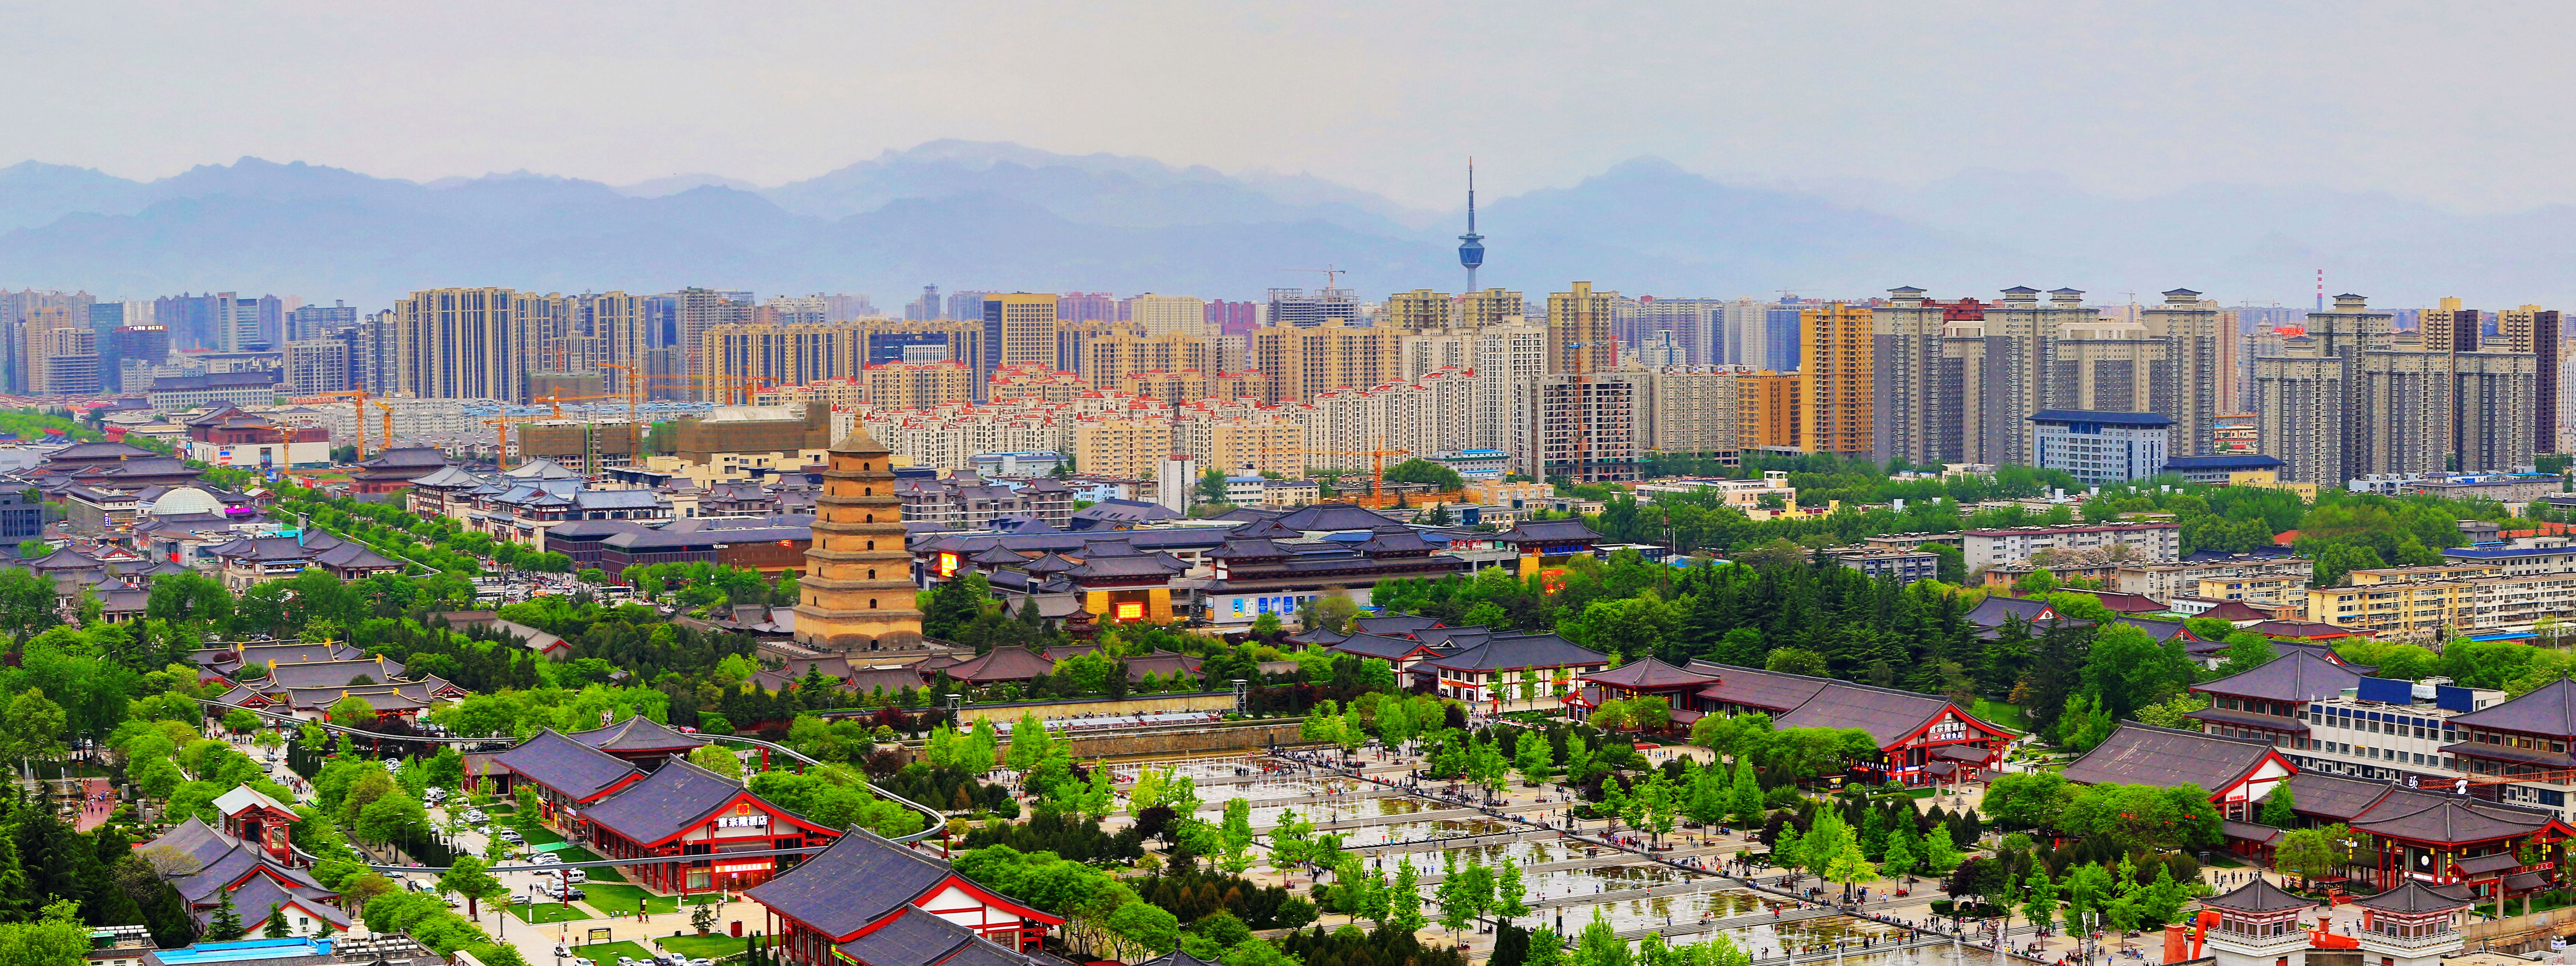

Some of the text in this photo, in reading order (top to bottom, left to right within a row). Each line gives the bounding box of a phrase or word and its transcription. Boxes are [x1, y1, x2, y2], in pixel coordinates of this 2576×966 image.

[1929, 722, 1967, 733] 唐宗隆酒店
[718, 815, 768, 828] 唐宗隆酒店
